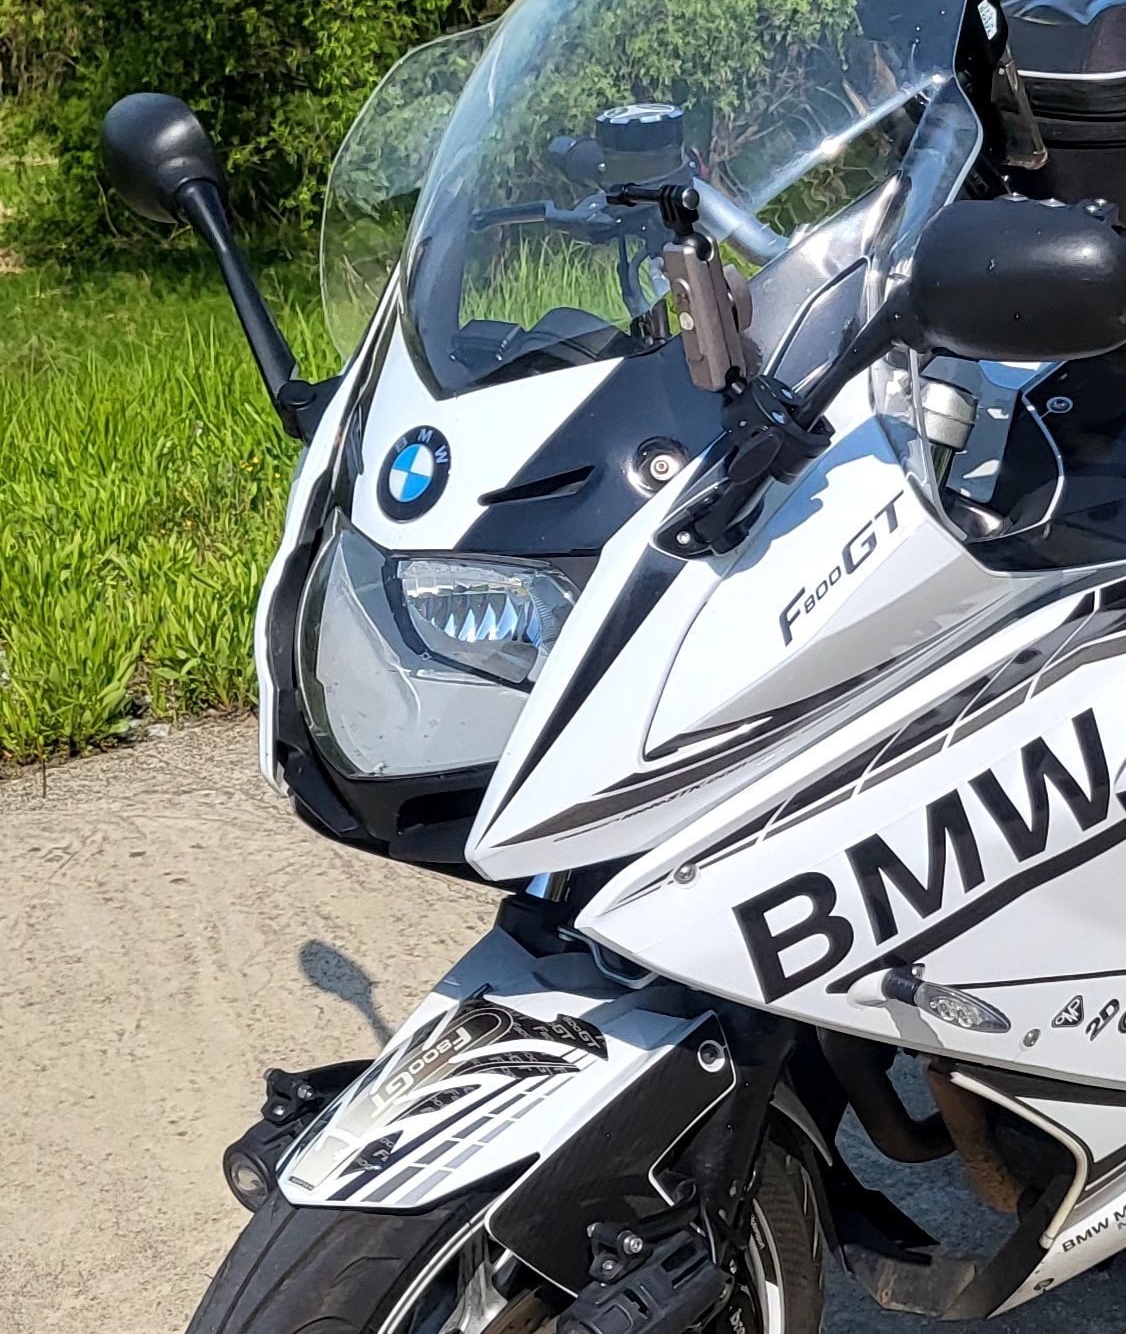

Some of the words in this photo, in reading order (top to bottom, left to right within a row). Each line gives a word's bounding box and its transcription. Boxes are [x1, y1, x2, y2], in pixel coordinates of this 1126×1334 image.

[394, 427, 449, 464] BMW
[779, 489, 904, 647] F800GT
[731, 707, 1111, 1004] BMW
[1085, 998, 1120, 1042] 2D
[371, 1026, 472, 1119] F800GT
[1062, 1217, 1109, 1252] BMW
